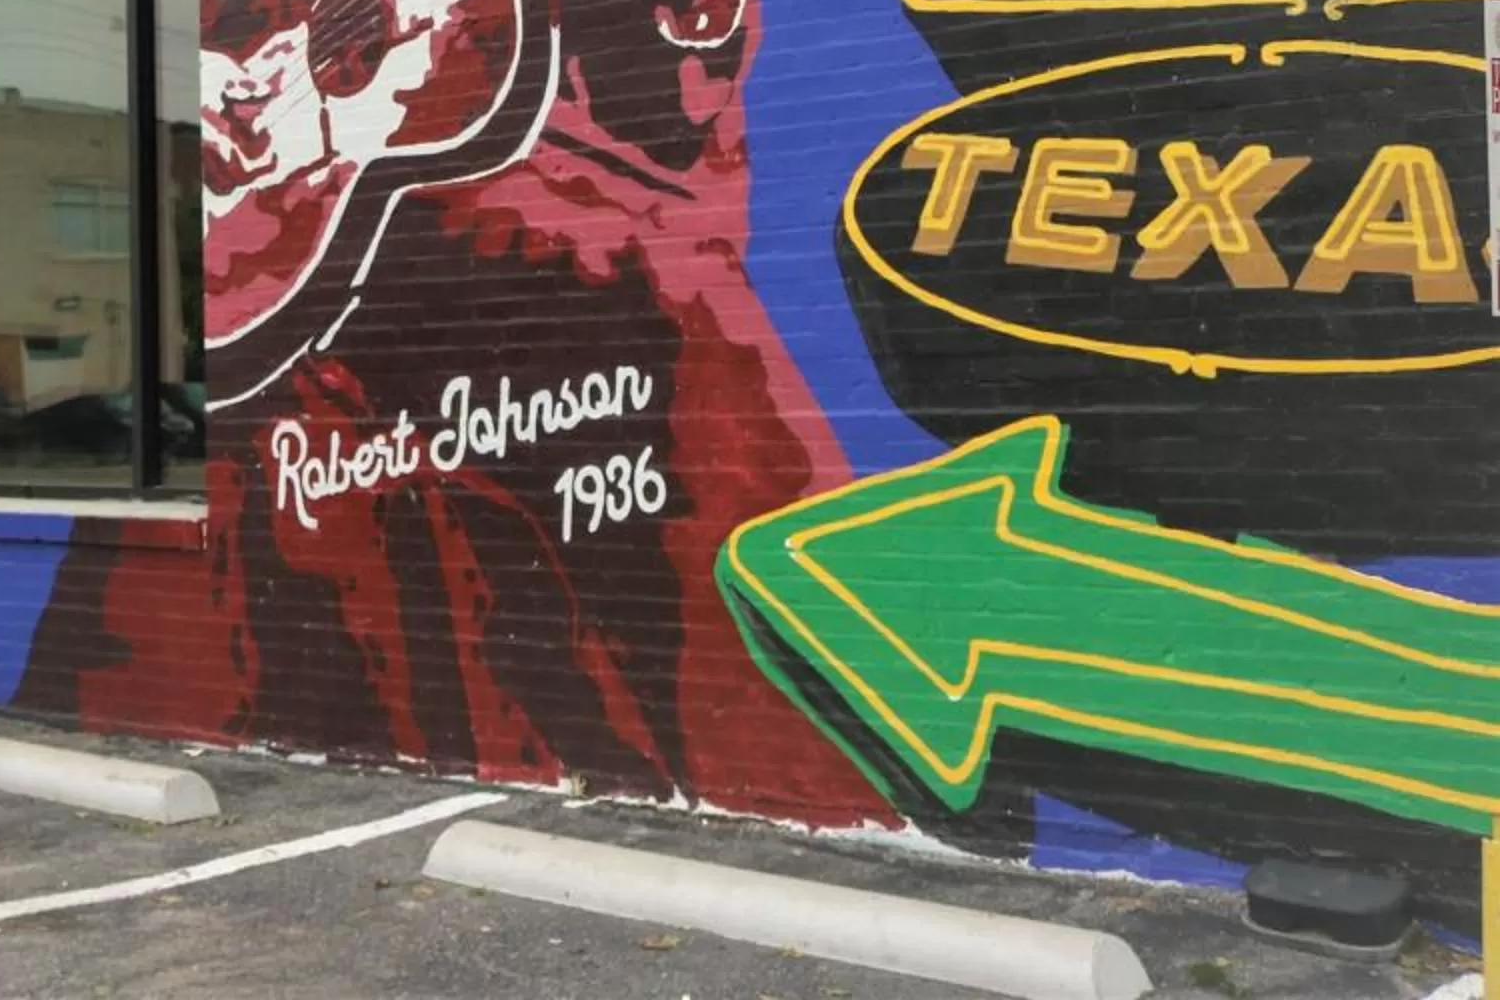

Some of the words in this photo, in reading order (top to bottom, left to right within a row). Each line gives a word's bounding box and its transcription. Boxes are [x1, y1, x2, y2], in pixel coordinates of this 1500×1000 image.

[901, 134, 1491, 303] TEXA
[272, 410, 419, 530] Robert
[429, 366, 652, 472] Johnson
[554, 446, 666, 543] 1936
